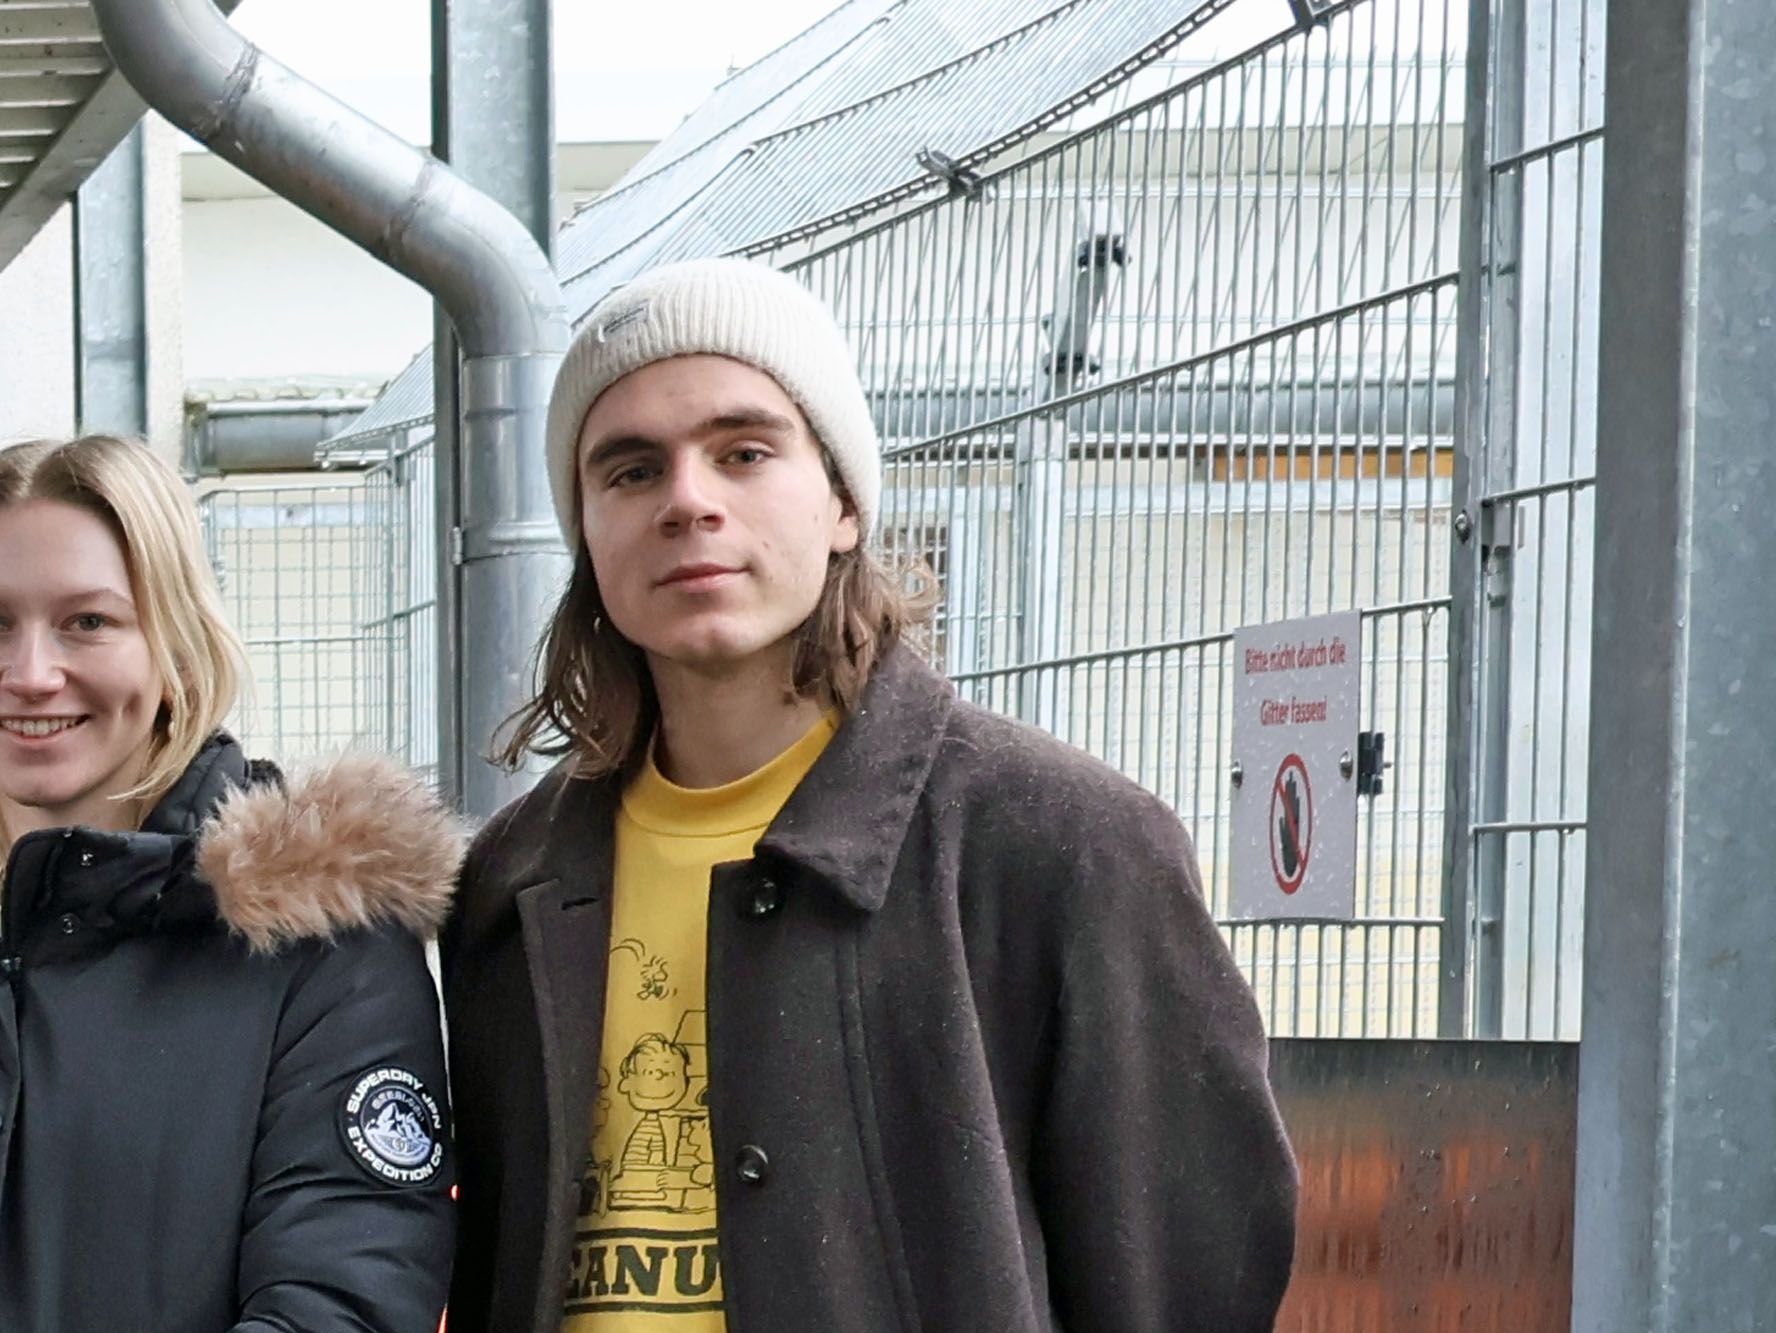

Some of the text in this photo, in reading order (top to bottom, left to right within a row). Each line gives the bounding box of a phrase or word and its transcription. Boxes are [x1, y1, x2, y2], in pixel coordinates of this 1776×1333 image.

[1245, 636, 1346, 674] Bitte nicht durch die
[1260, 698, 1288, 725] Gitter
[347, 1069, 423, 1114] SUPERDRY
[421, 1092, 442, 1129] JPN
[347, 1126, 434, 1181] EXPEDITION
